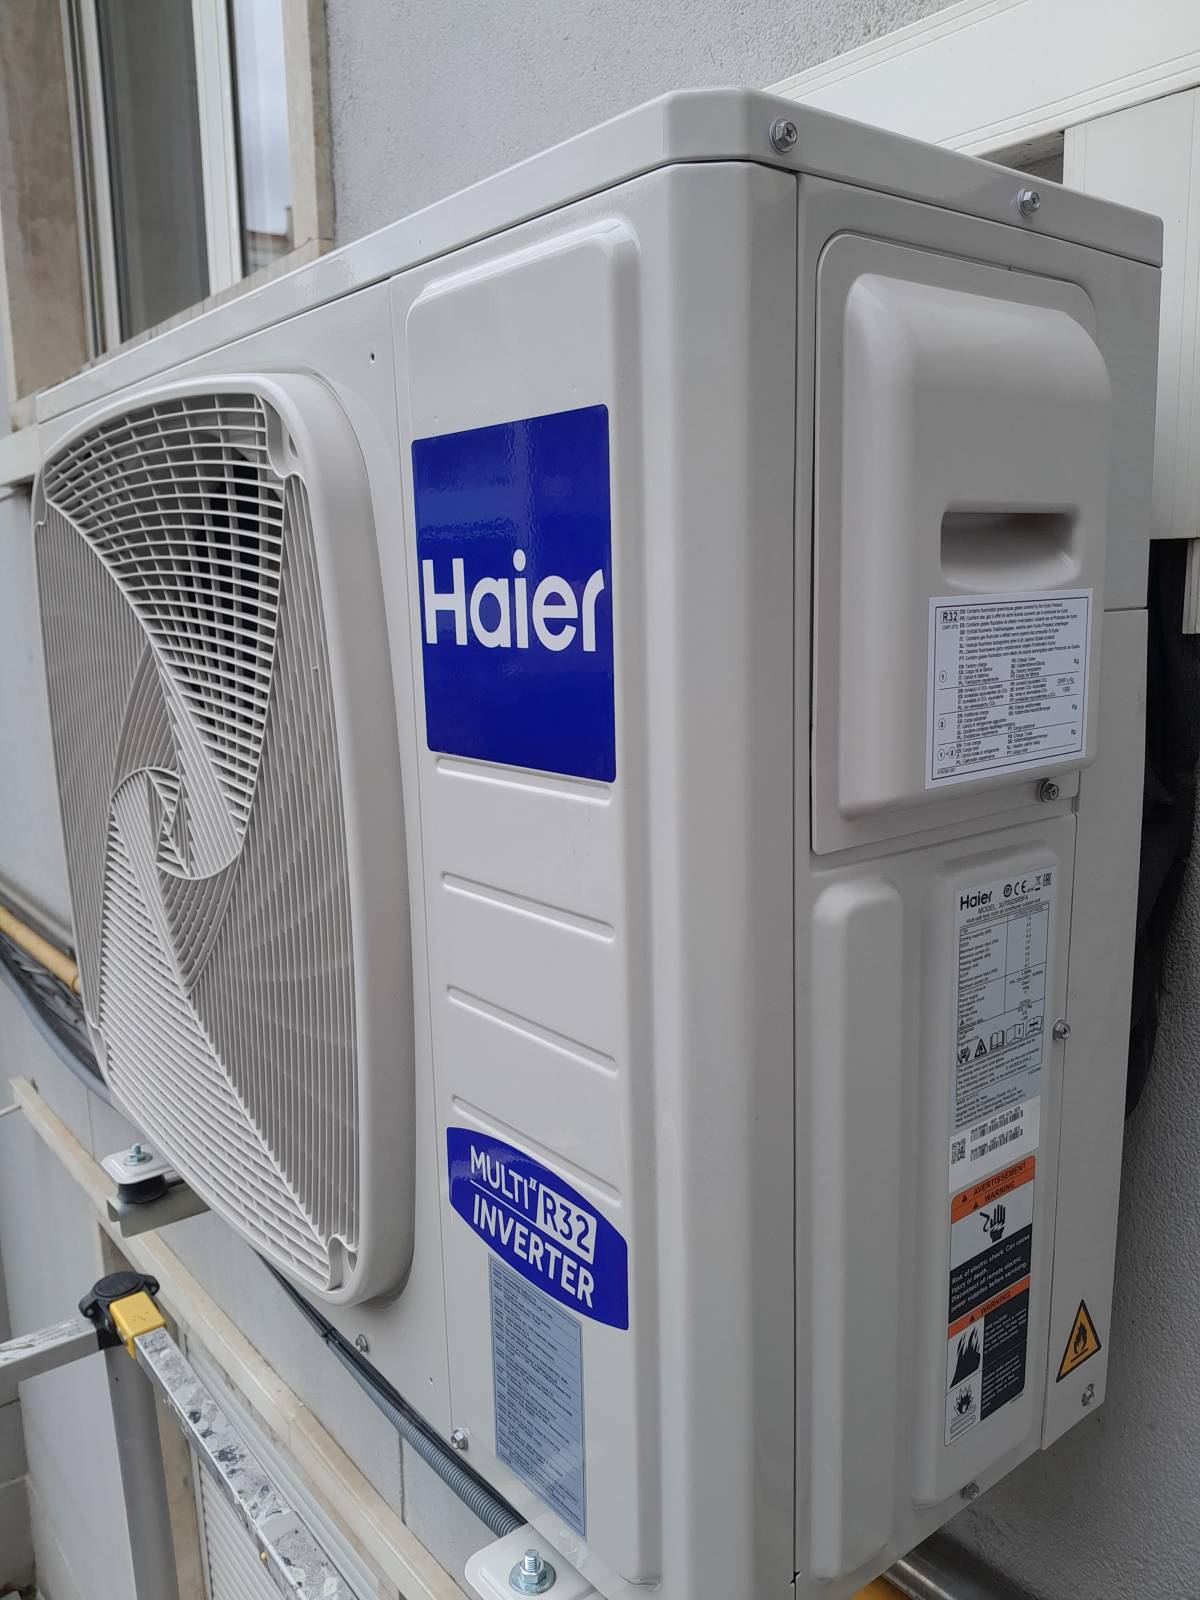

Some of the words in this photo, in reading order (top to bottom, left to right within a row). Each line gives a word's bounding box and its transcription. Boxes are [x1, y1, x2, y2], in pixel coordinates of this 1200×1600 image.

[422, 549, 605, 652] Haier
[942, 611, 958, 622] R32
[960, 890, 993, 911] Haier
[973, 1162, 1026, 1196] AVERTISSEMENT
[984, 1180, 1015, 1202] WARNING
[470, 1145, 529, 1210] MULTI
[543, 1193, 591, 1255] R32
[473, 1194, 595, 1309] INVERTER
